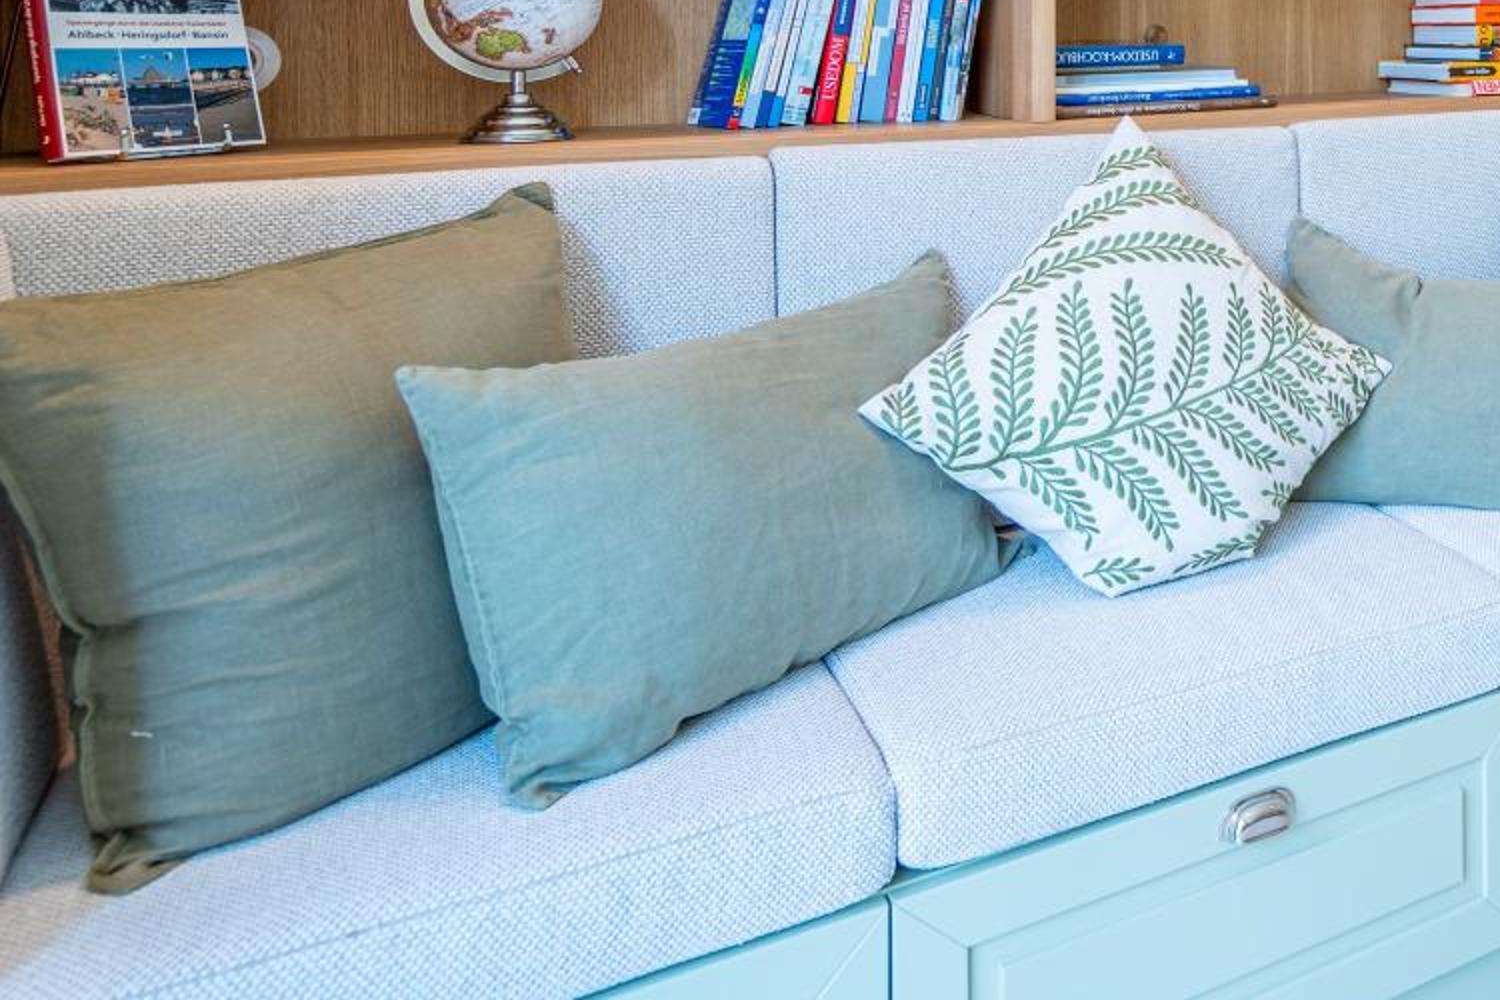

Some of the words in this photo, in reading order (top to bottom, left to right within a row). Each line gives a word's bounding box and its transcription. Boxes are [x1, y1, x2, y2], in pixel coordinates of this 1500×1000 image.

[67, 30, 114, 39] Ahlbeck
[121, 30, 186, 42] Heringsdorf
[192, 31, 229, 39] Bansin
[822, 38, 845, 101] USEDOM
